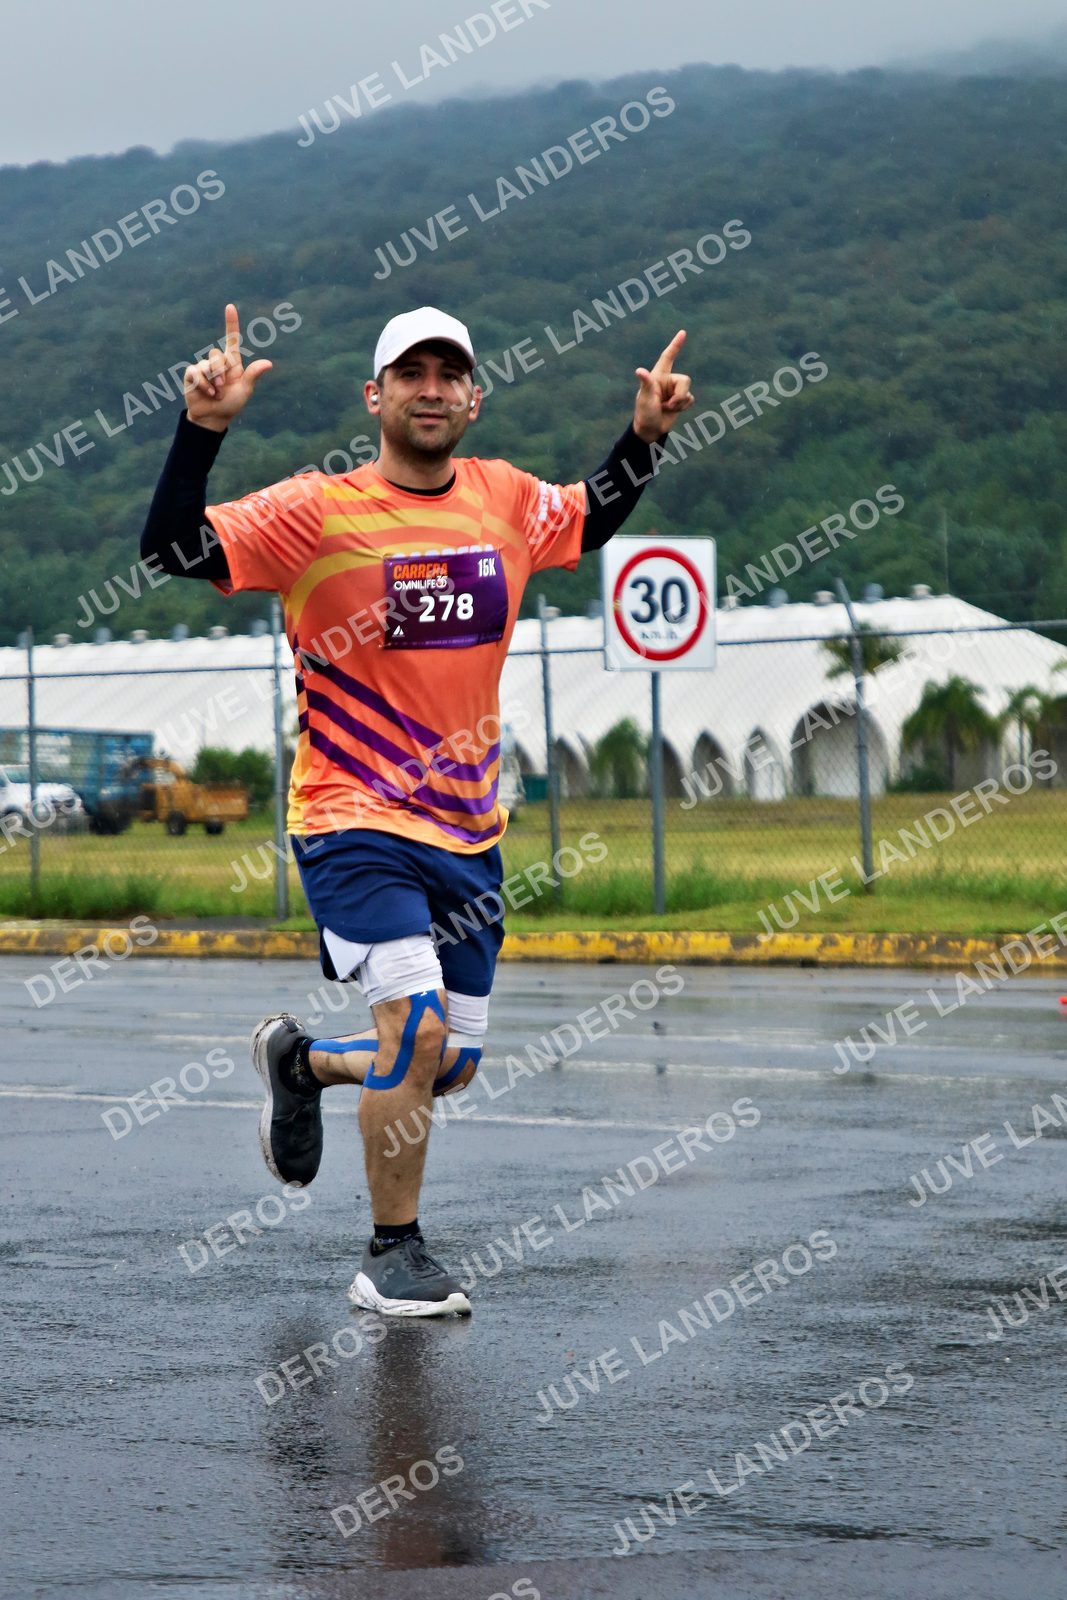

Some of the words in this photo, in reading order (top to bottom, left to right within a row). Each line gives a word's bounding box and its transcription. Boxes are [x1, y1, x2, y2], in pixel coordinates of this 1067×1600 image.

[394, 563, 448, 579] CARRERA
[394, 580, 435, 590] OMNILIFE
[418, 593, 474, 622] 278
[630, 576, 690, 624] 30
